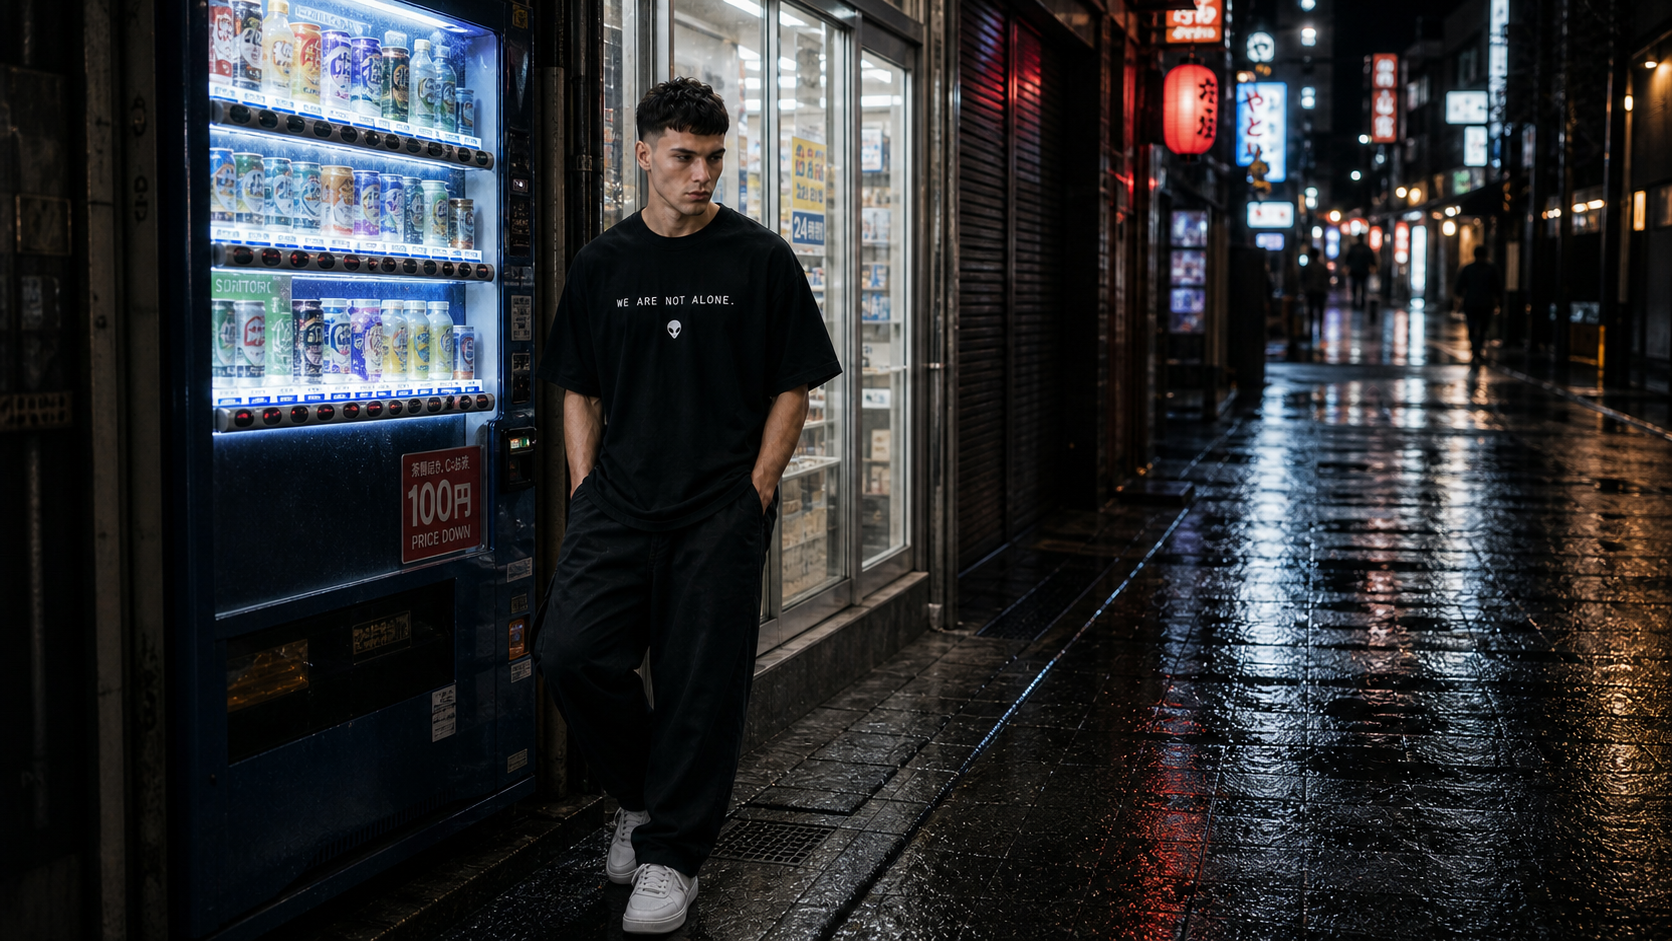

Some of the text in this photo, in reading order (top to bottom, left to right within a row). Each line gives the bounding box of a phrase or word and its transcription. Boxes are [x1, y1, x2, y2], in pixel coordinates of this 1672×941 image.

[616, 295, 735, 308] WE ARE NOT ALONE.
[407, 478, 472, 528] 100円
[411, 524, 471, 550] PRICE DOWN
